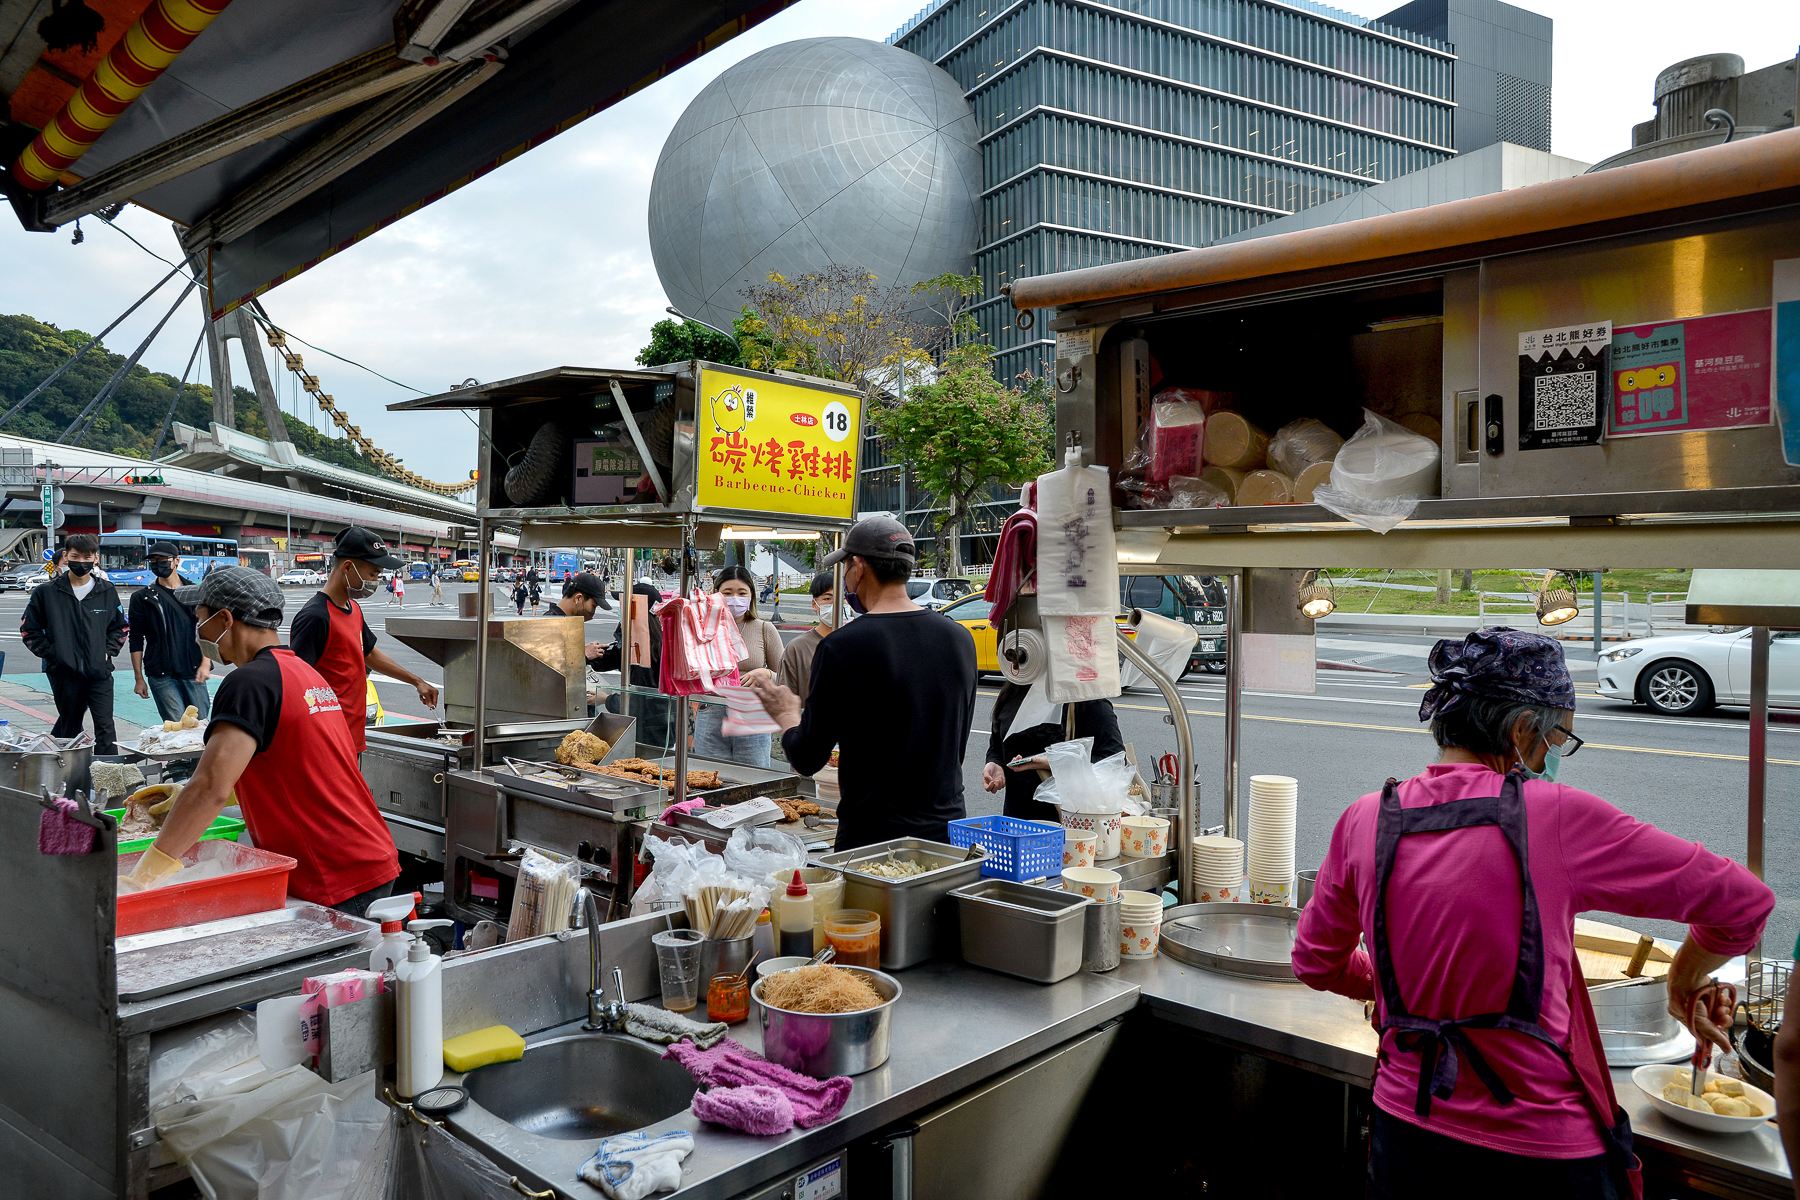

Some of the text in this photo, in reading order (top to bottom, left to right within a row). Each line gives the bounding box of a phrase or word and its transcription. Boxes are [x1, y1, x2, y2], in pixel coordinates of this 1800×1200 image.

[1543, 326, 1607, 343] 台北熊好券
[1613, 337, 1679, 355] 台北熊好市集券
[1695, 355, 1744, 368] 基河臭豆腐
[794, 414, 815, 426] 士林店
[826, 411, 848, 432] 18
[709, 431, 853, 484] 碳烤雞排
[714, 474, 847, 501] Barbecue-Chicken
[1194, 610, 1205, 622] APC
